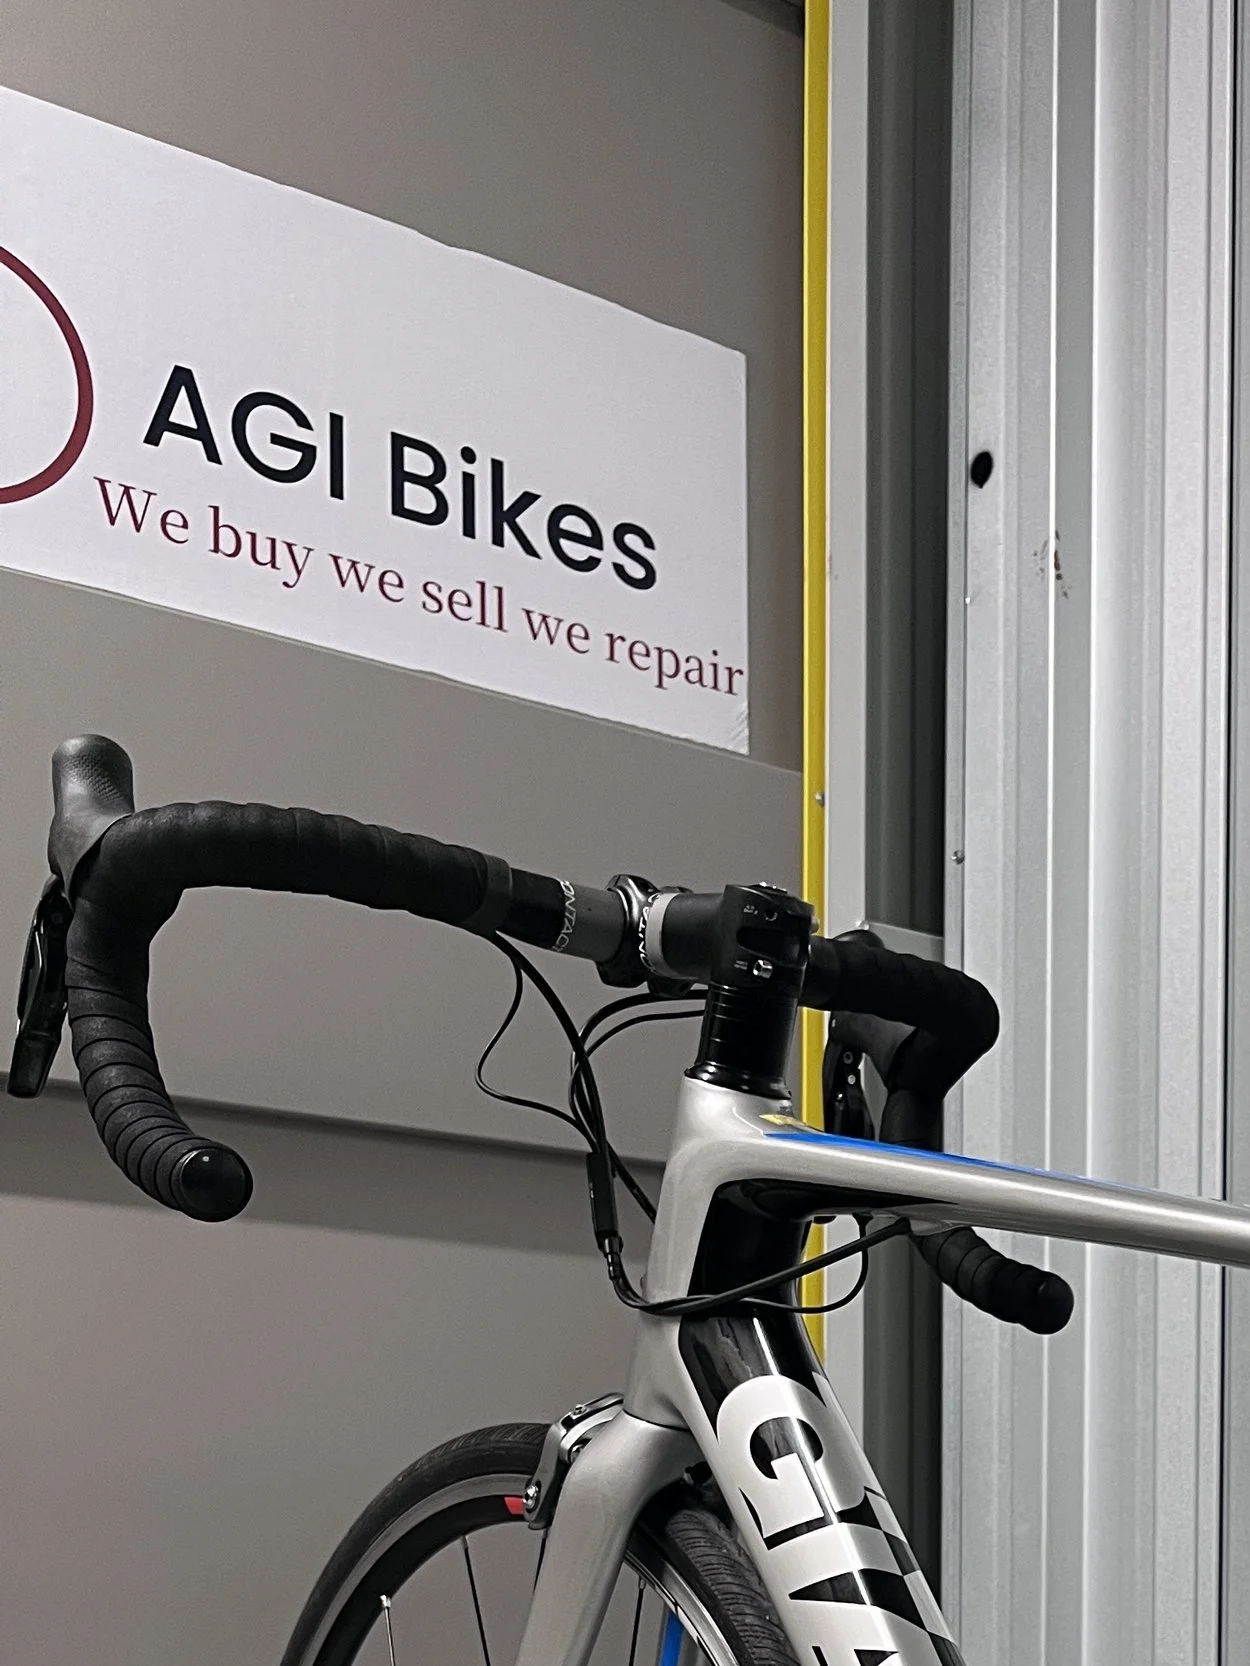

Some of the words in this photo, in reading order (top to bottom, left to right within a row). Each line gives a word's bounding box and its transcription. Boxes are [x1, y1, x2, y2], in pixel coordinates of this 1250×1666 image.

[94, 476, 189, 545] We
[208, 505, 314, 588] buy
[328, 555, 405, 602] we
[421, 580, 508, 633] sell
[522, 607, 591, 655] we
[604, 631, 744, 697] repair
[143, 364, 345, 501] AGI
[389, 430, 658, 591] Bikes
[552, 880, 576, 952] ONTAC
